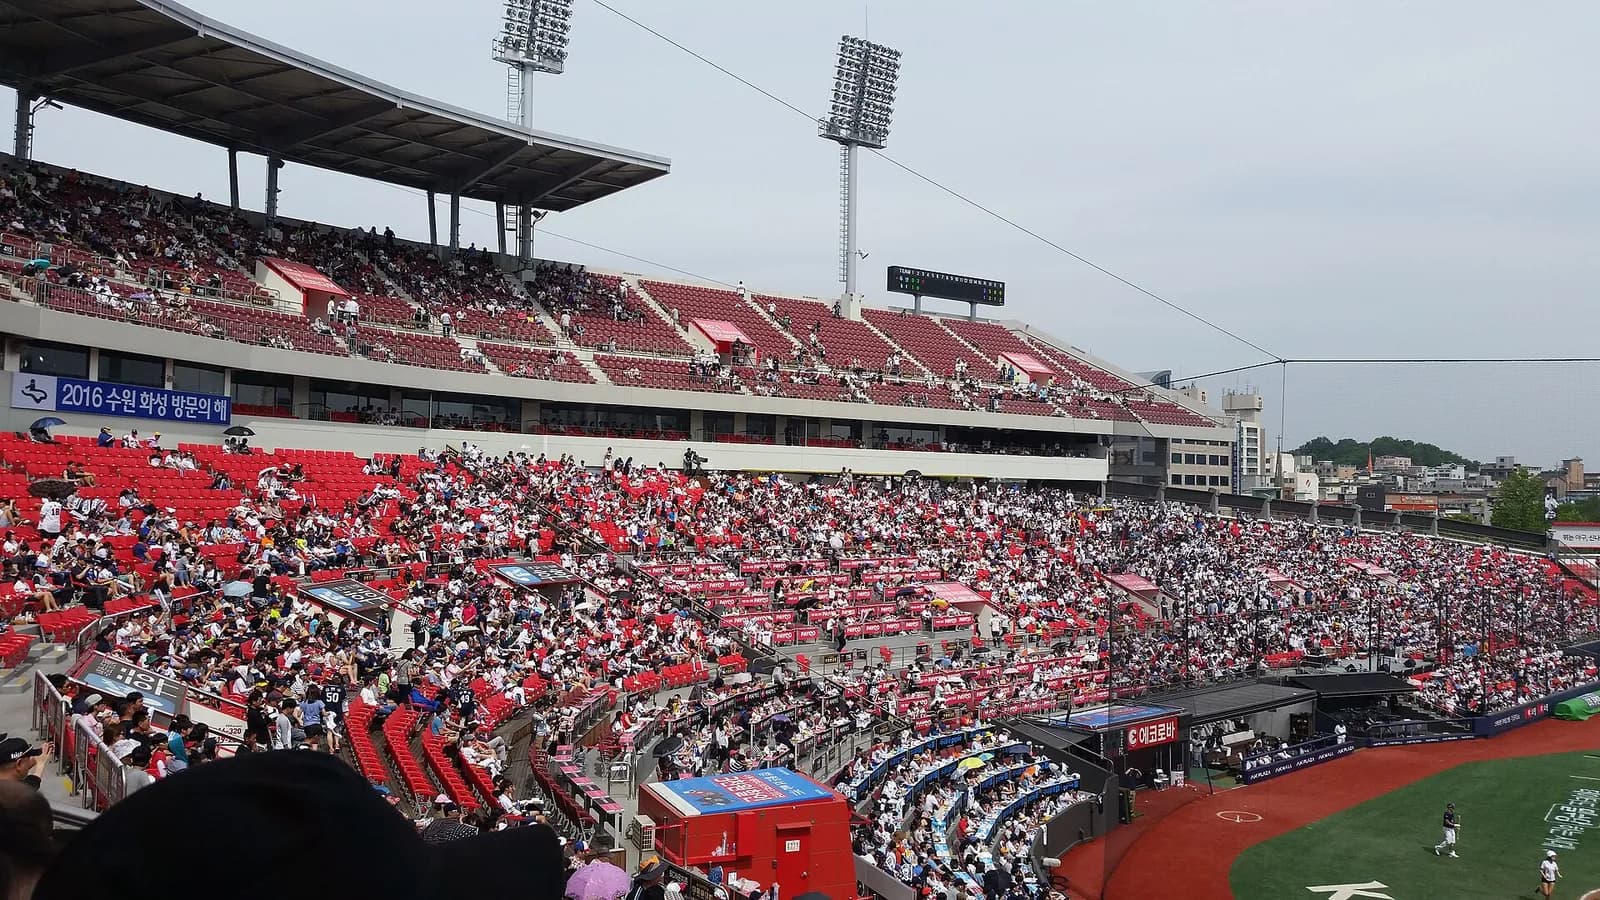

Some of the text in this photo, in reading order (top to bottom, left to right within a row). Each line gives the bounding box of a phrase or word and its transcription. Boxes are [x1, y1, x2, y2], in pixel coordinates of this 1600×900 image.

[62, 384, 227, 421] 2016 수원 화성 방문의 해
[326, 692, 339, 702] 50
[461, 694, 470, 703] 49
[1140, 721, 1176, 745] 에코로바
